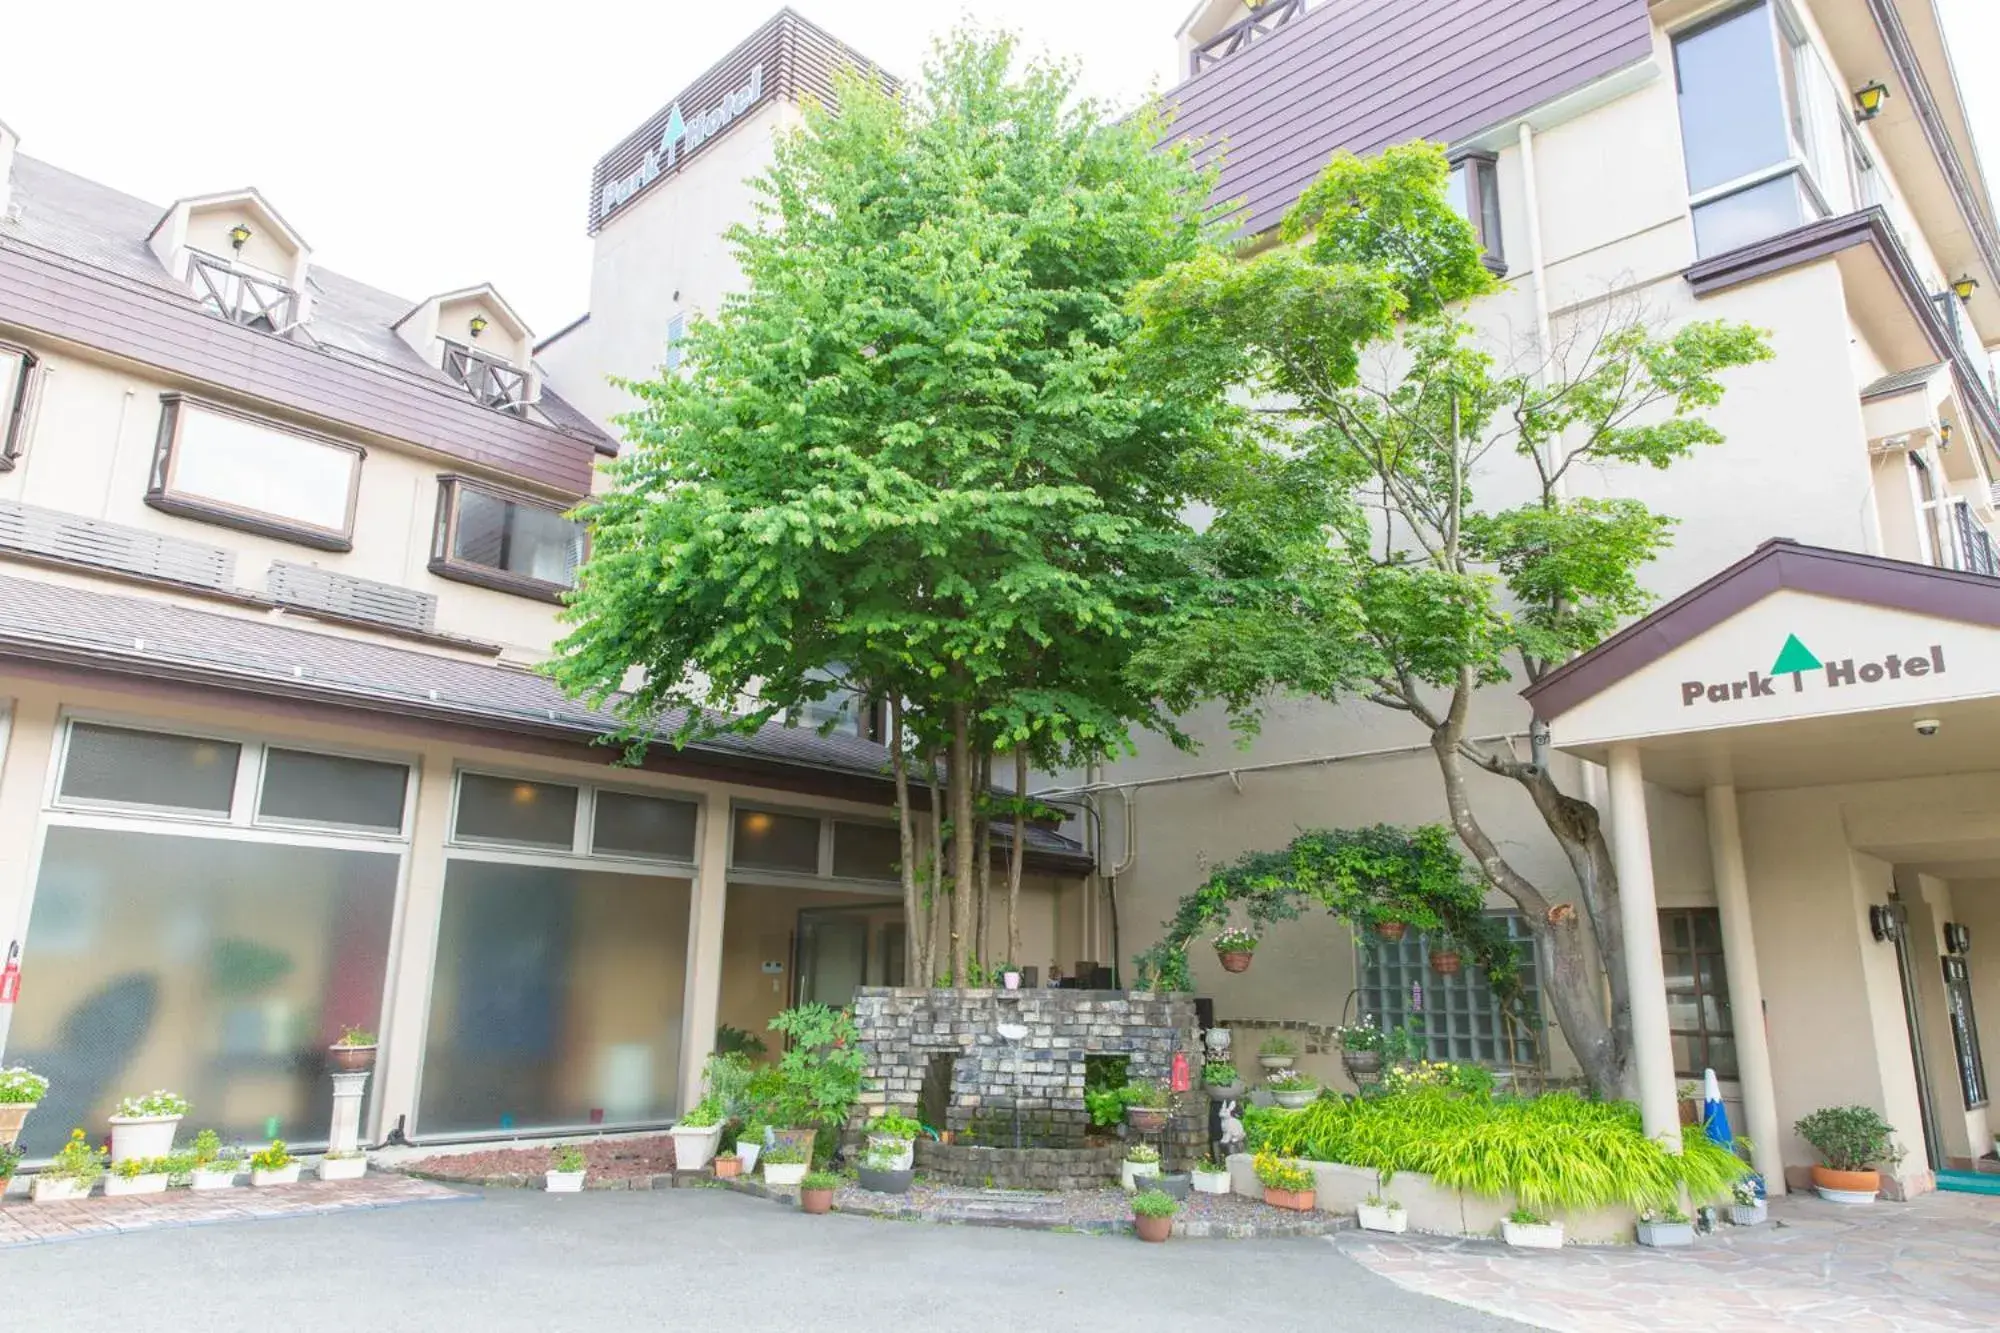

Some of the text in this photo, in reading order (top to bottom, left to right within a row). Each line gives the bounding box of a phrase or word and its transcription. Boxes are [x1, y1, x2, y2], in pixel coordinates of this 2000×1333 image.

[601, 64, 762, 216] Park Hotel
[1681, 645, 1946, 706] Park Hotel
